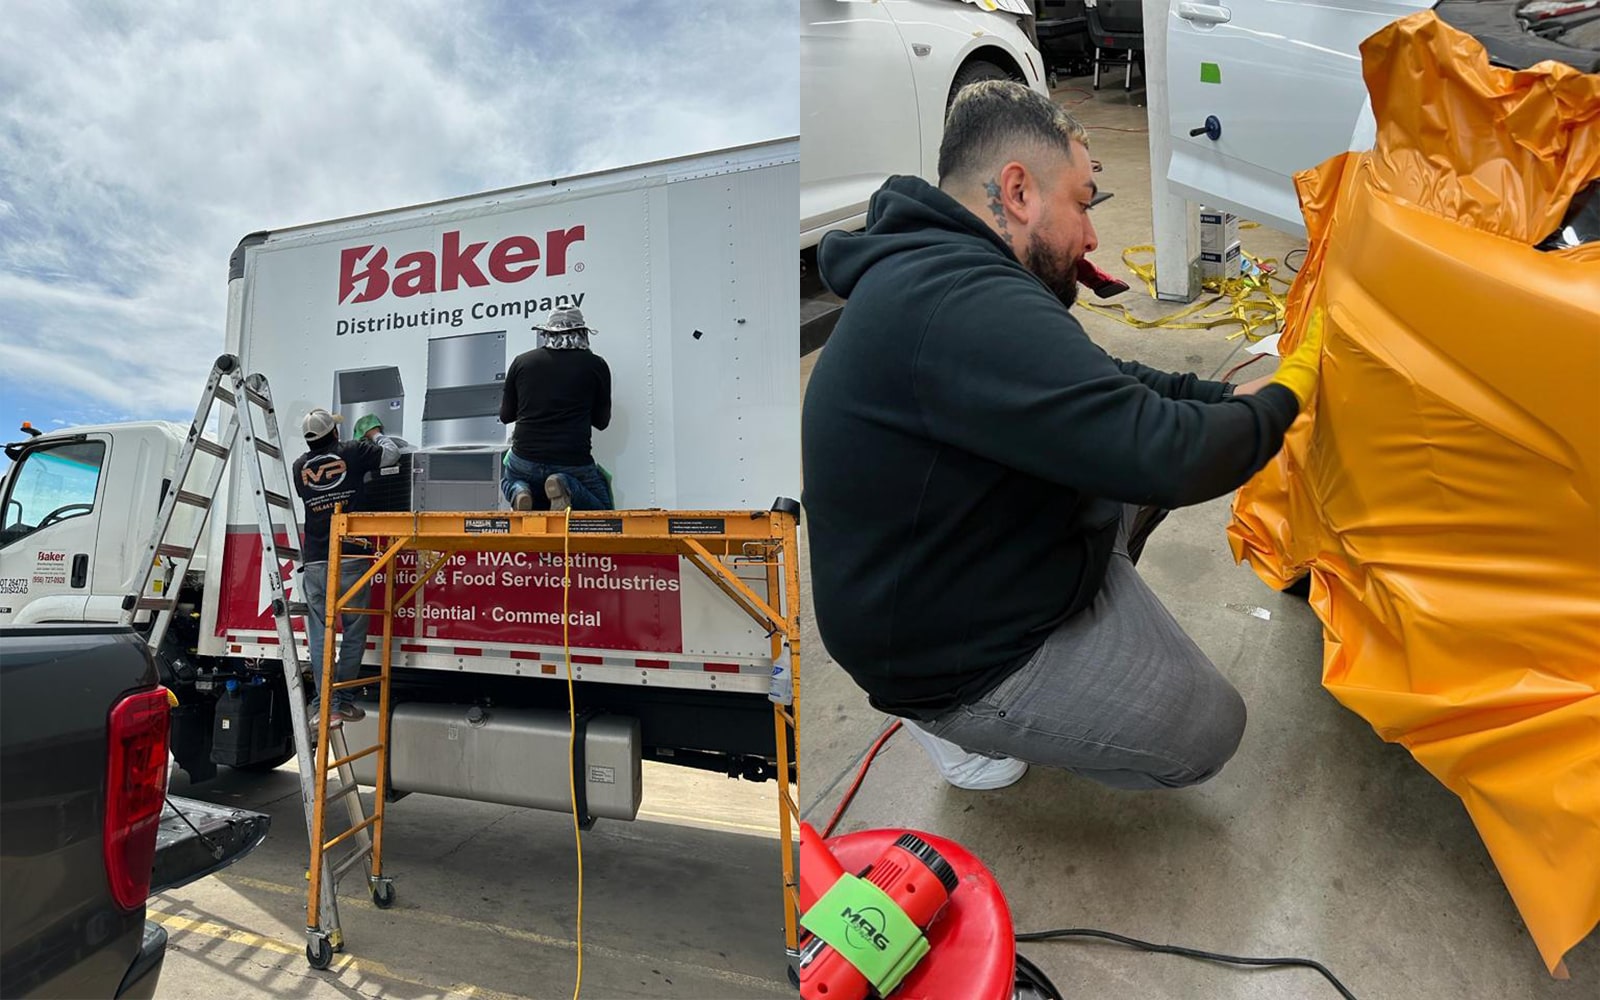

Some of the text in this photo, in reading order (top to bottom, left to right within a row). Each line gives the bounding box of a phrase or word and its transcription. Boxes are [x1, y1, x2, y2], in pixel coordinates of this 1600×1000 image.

[338, 225, 585, 306] Baker
[336, 307, 463, 336] Distributing
[38, 551, 65, 561] Baker
[477, 551, 533, 569] HVAC,
[538, 552, 618, 572] Heating,
[434, 570, 447, 585] &
[452, 571, 497, 586] Food
[501, 571, 571, 588] Service
[577, 573, 680, 592] Industries
[394, 604, 475, 621] esidential
[840, 906, 890, 951] MAG
